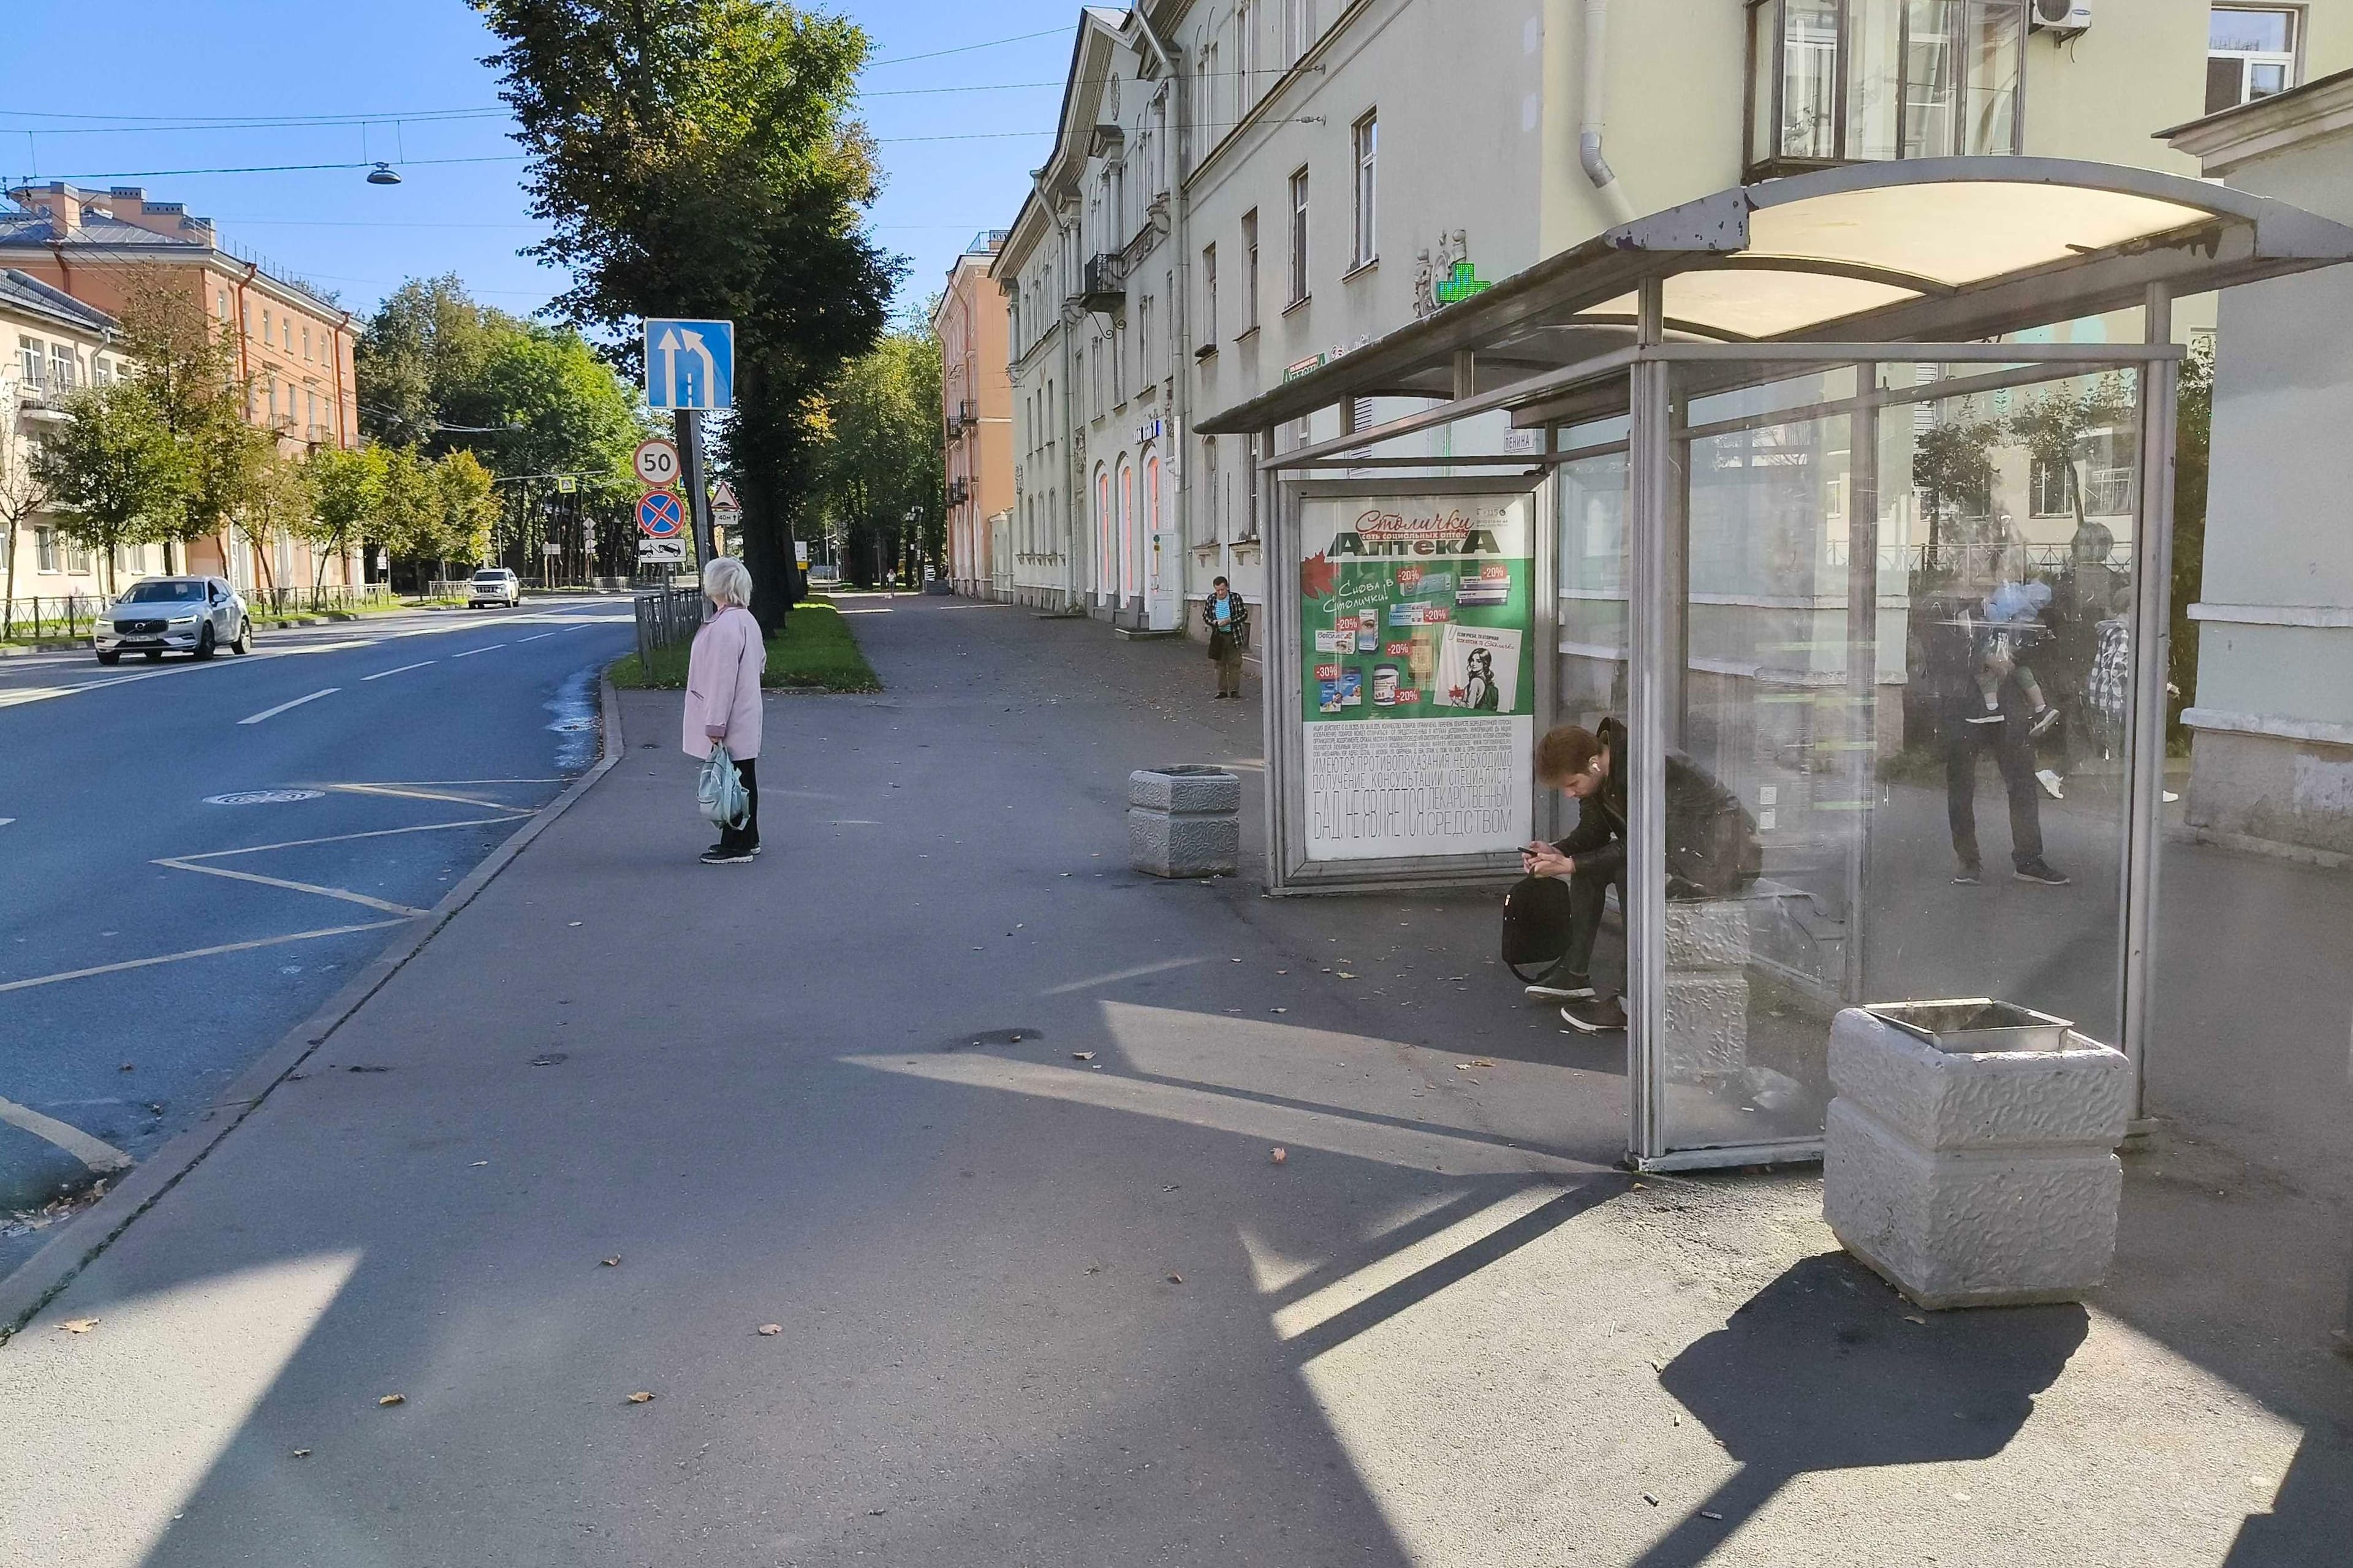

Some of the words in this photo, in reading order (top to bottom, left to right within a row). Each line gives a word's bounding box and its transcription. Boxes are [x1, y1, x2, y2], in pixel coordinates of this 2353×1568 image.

[645, 453, 671, 472] 50
[1355, 509, 1474, 532] Столички
[1398, 570, 1420, 581] -20%
[1483, 567, 1504, 578] -20%
[1425, 610, 1446, 620] -20%
[1337, 618, 1357, 629] -20%
[1388, 643, 1408, 654] -20%
[1317, 666, 1338, 677] -30%
[1396, 691, 1418, 702] -20%
[1313, 756, 1354, 773] ИМЕЮТСЯ
[1454, 751, 1512, 769] НЕОБХОДИМО
[1313, 773, 1365, 790] ПОЛУЧЕНИЕ
[1372, 770, 1443, 789] КОНСУЛЬТАЦИИ
[1346, 789, 1360, 839] НЕ
[1363, 788, 1424, 838] ЯВЛЯЕТСЯ
[1428, 784, 1512, 810] ЛЕКАРСТВЕННЫМ
[1427, 809, 1512, 838] СРЕДСТВОМ
